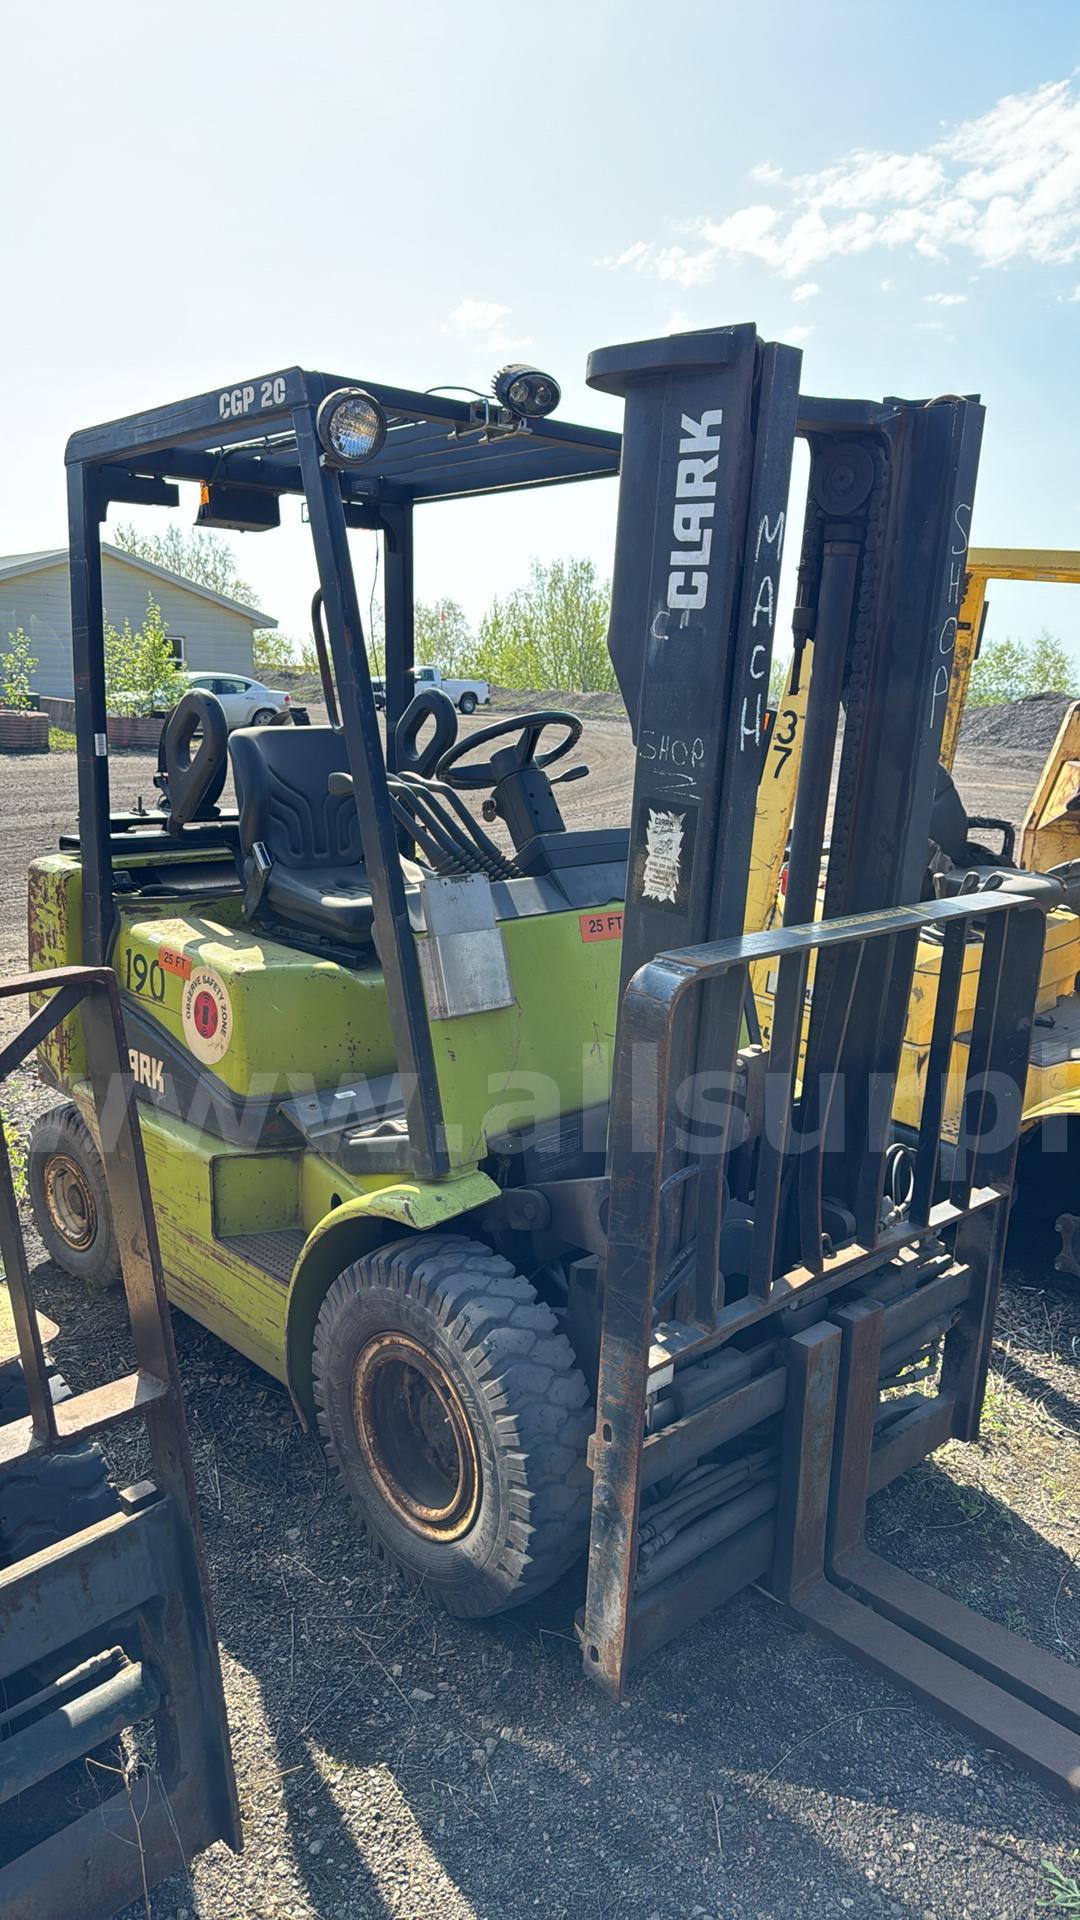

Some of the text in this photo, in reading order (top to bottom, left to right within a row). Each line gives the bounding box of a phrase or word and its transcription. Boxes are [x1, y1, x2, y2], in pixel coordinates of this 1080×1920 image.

[219, 386, 255, 419] CGP
[666, 409, 723, 610] CLARK
[739, 511, 785, 752] MACH
[587, 916, 623, 934] 25 FT
[125, 948, 166, 1002] 190
[163, 951, 187, 970] 25 FT
[185, 974, 228, 1038] OBSERVE SAFETY ZONE
